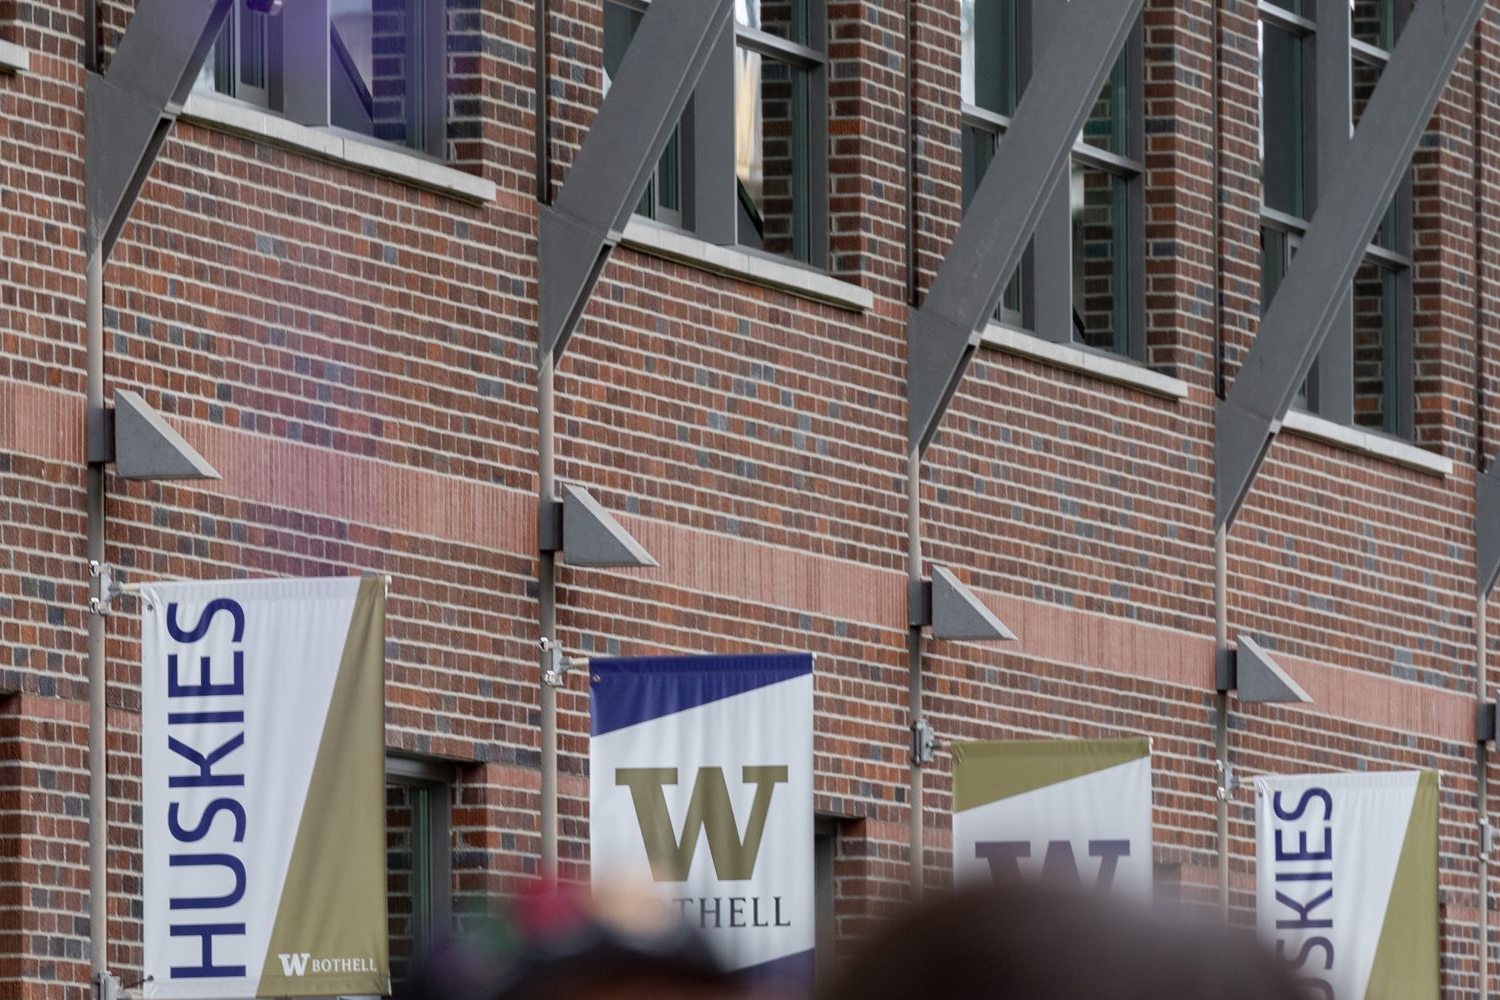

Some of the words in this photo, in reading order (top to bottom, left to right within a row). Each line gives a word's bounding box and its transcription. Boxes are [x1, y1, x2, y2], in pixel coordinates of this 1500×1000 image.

[166, 597, 247, 979] HUSKIES
[615, 765, 789, 882] W
[672, 896, 791, 928] THELL
[278, 952, 311, 977] W
[312, 957, 378, 973] BOTHELL
